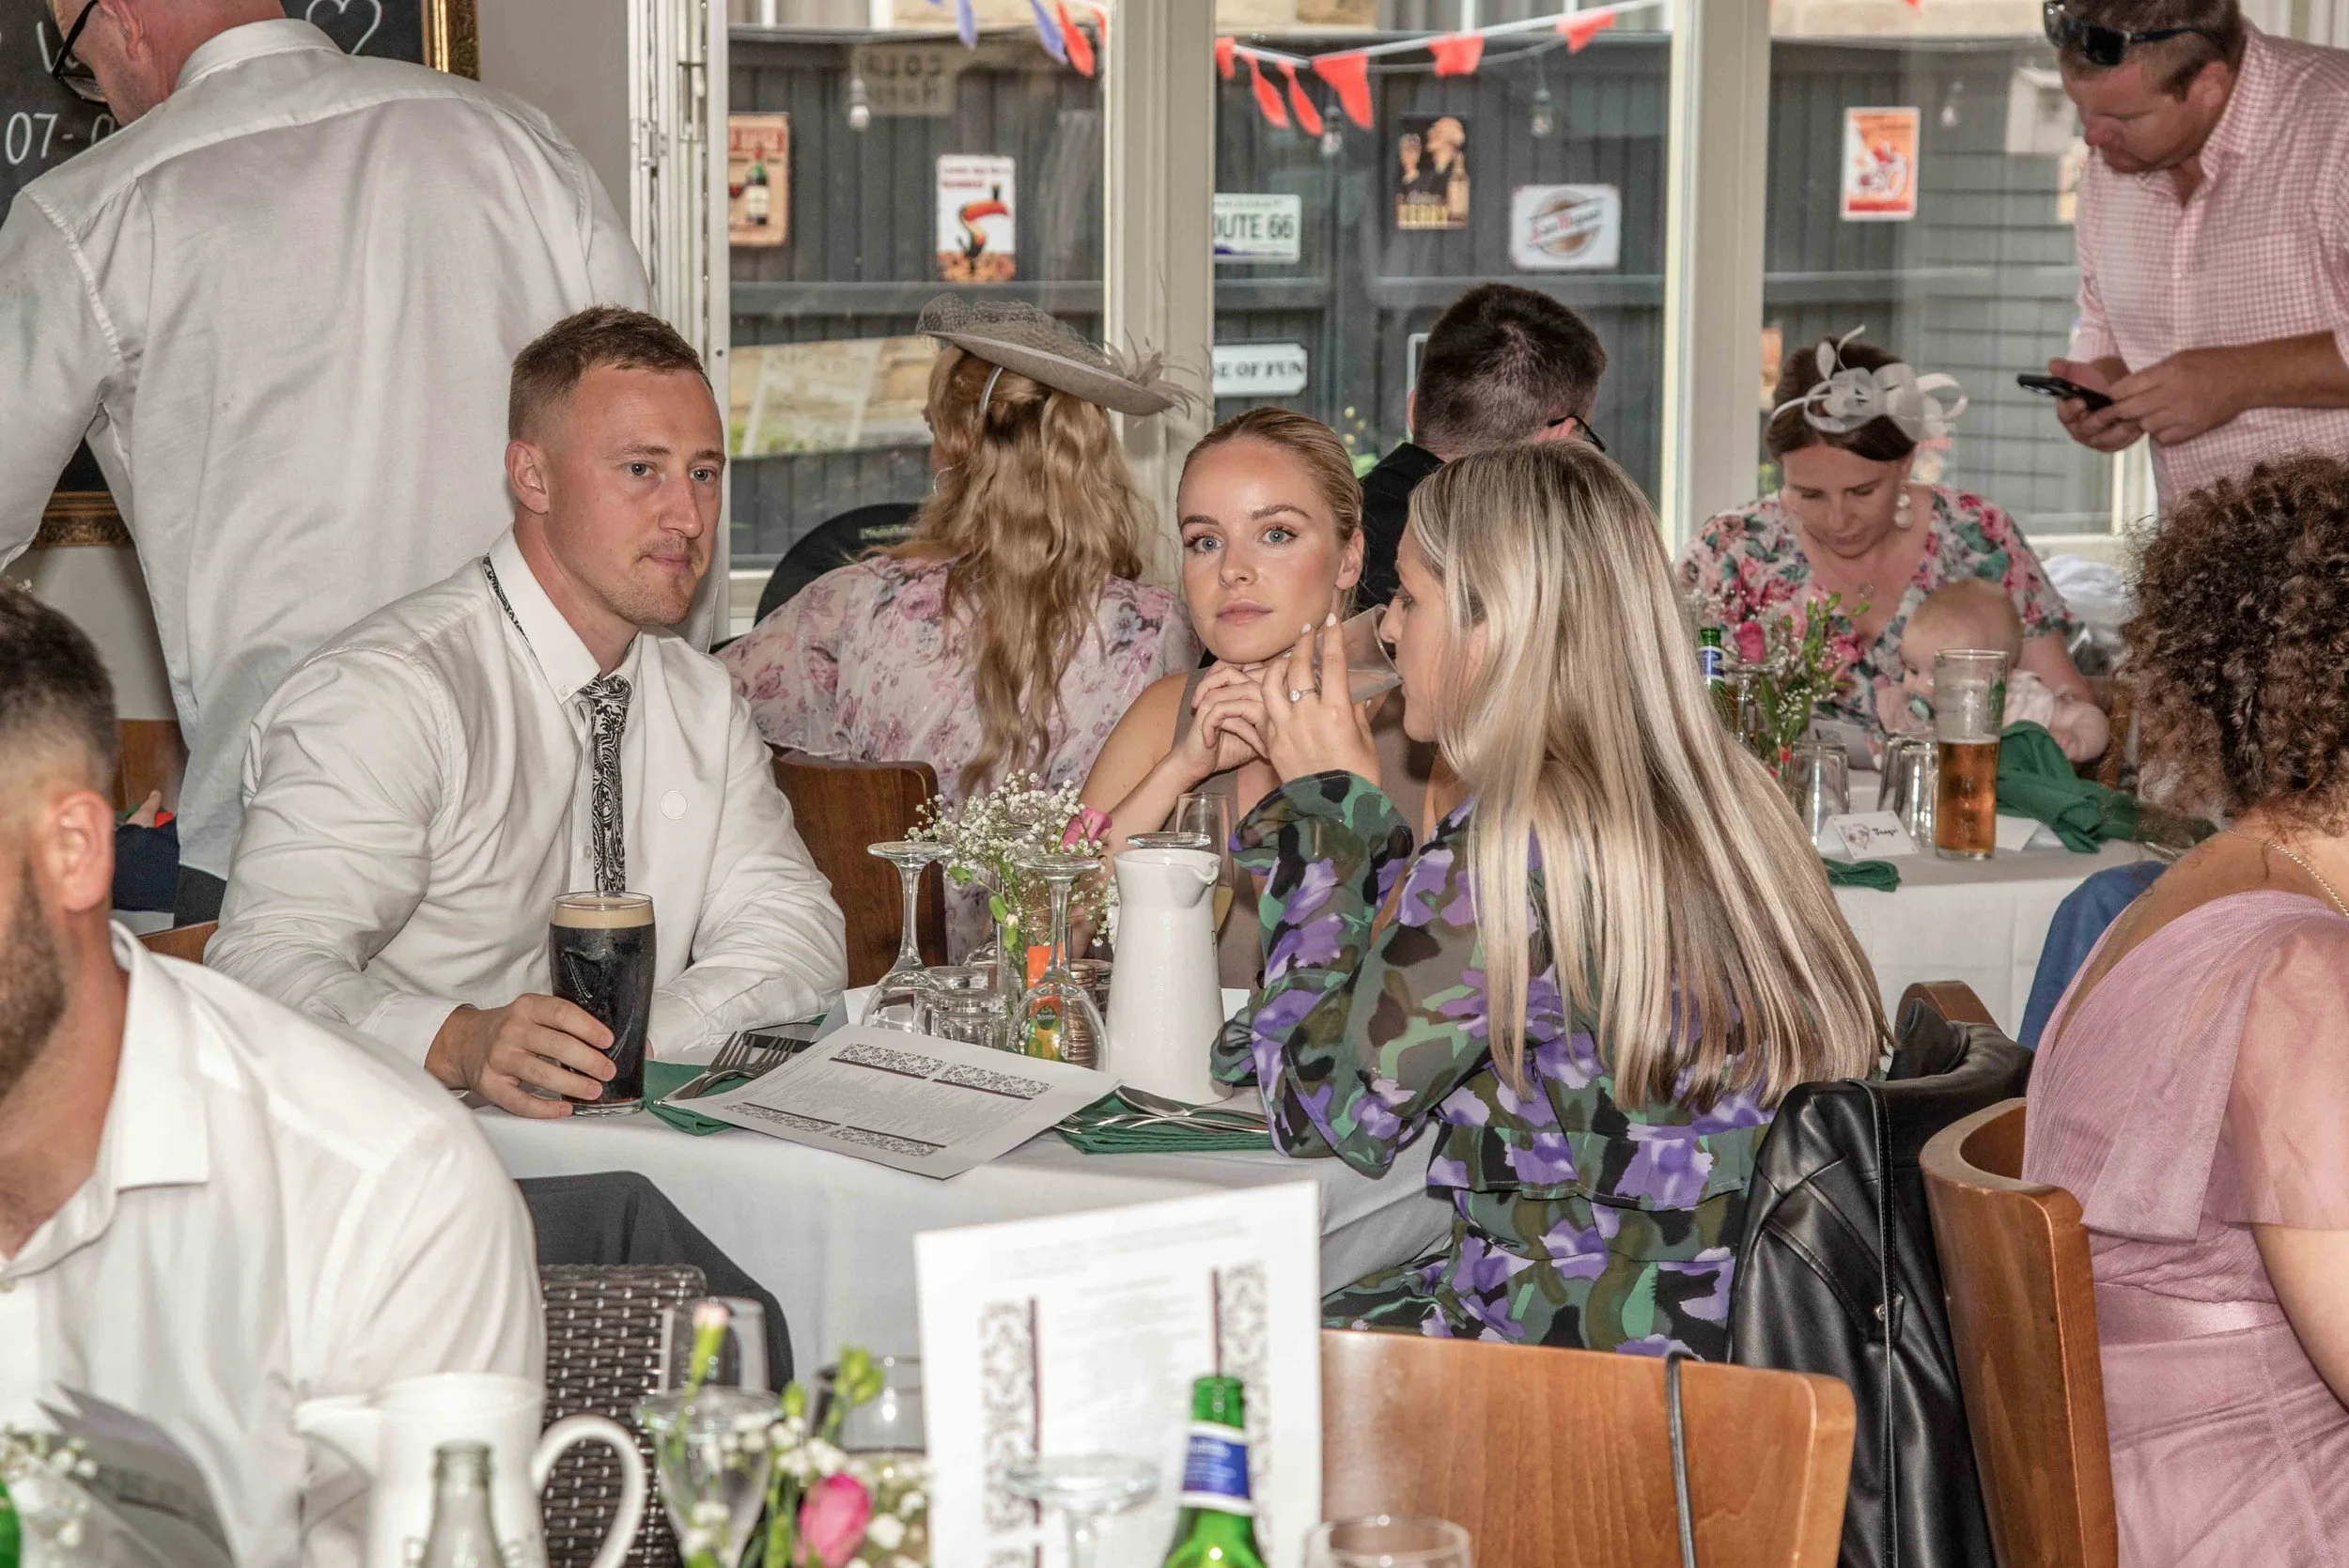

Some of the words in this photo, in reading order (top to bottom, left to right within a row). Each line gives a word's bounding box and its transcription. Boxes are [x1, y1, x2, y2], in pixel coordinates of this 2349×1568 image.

[1267, 212, 1295, 240] 66
[1236, 361, 1262, 379] OF
[1265, 359, 1305, 378] FUN
